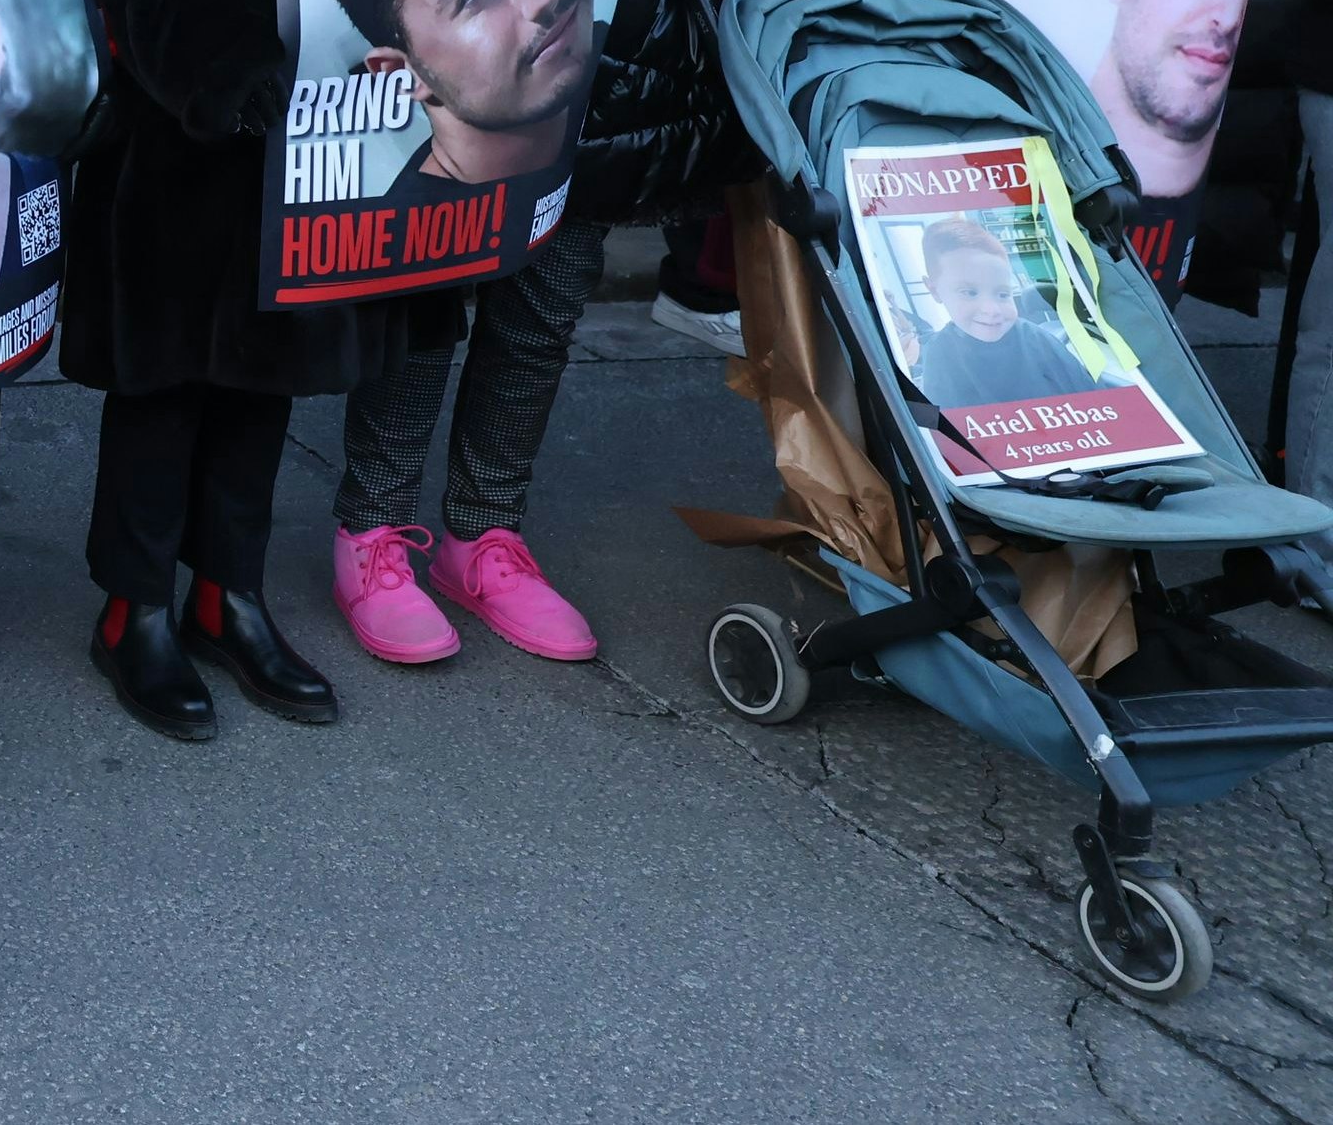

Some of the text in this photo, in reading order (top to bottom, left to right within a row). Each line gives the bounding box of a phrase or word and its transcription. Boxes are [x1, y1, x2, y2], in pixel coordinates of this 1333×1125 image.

[287, 69, 412, 136] BRING
[284, 138, 360, 204] HIM
[856, 161, 1031, 198] KIDNAPPED
[281, 183, 507, 277] HOME NOW!
[20, 298, 34, 322] AND
[963, 402, 1119, 441] Ariel Bibas
[1004, 430, 1112, 461] 4 years old
